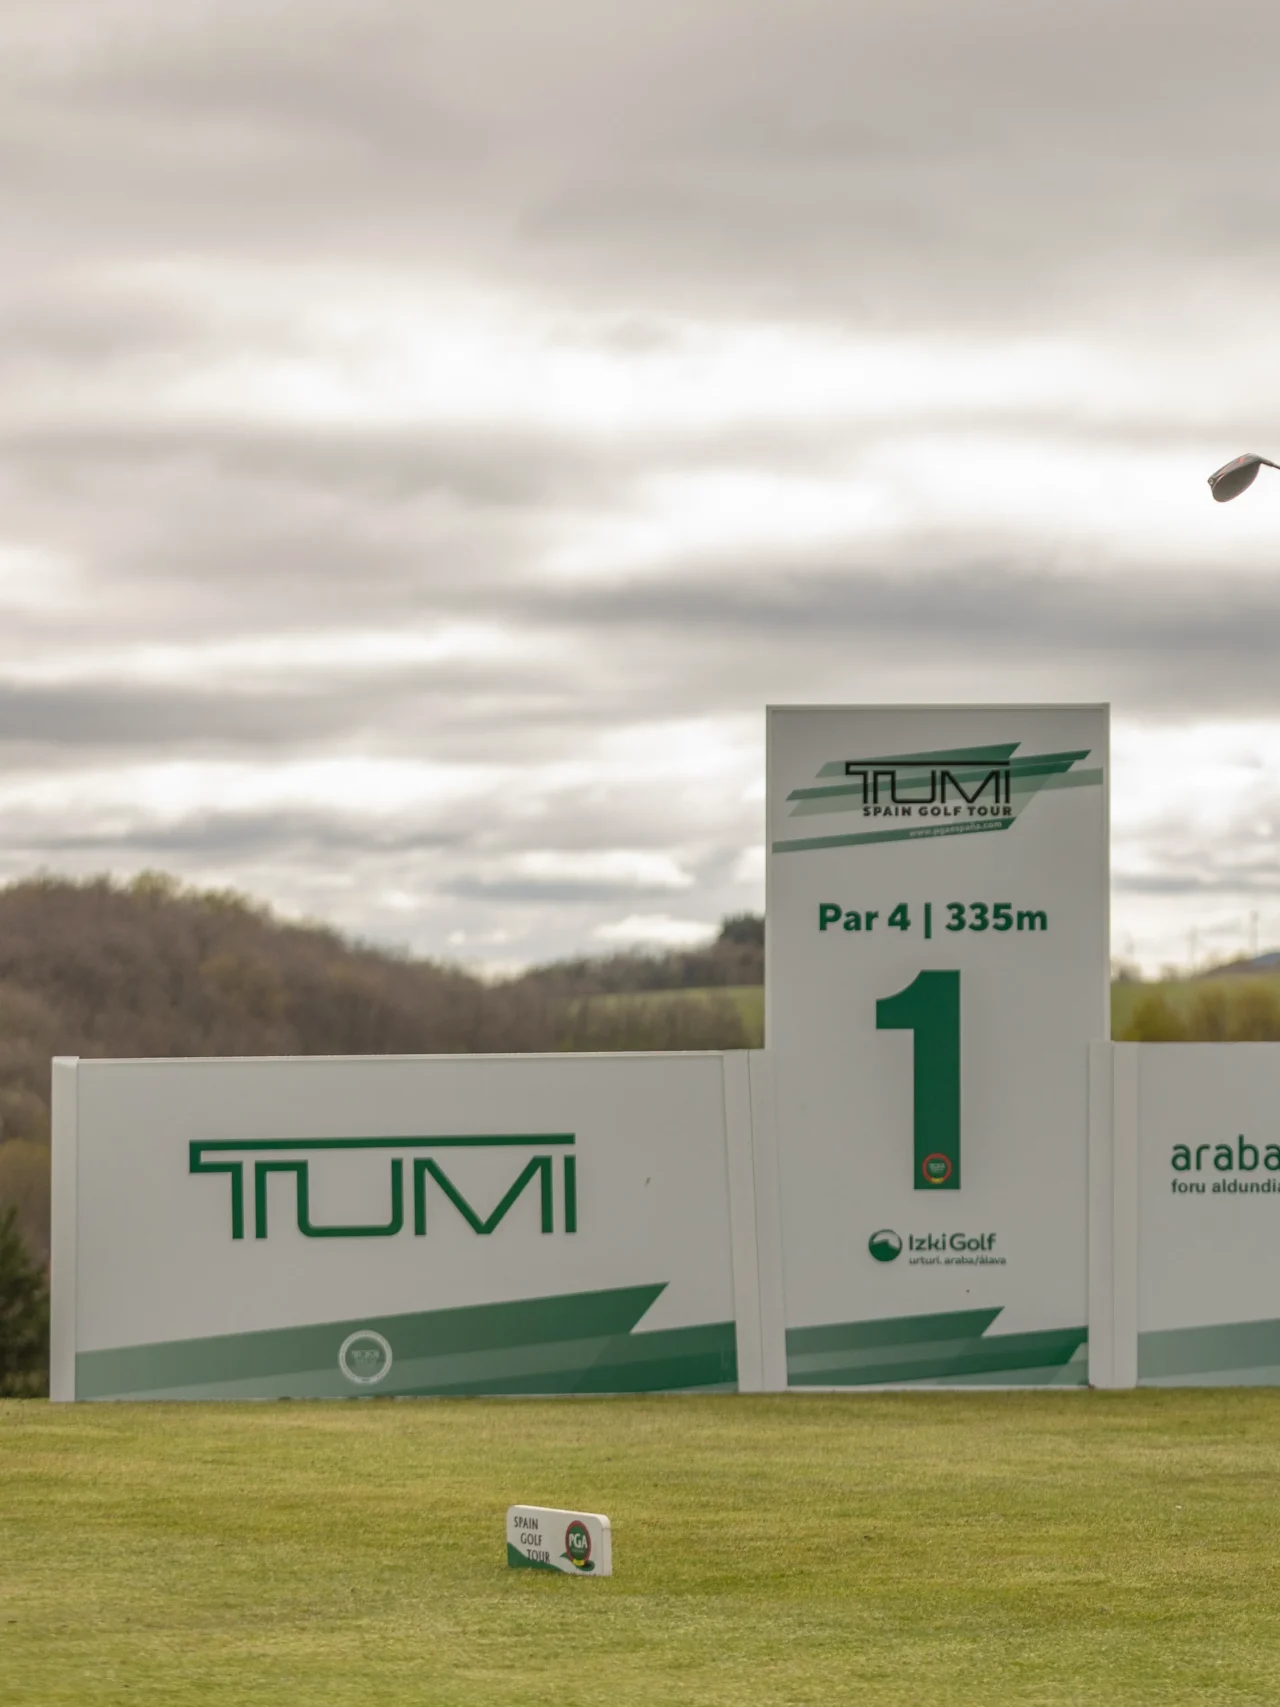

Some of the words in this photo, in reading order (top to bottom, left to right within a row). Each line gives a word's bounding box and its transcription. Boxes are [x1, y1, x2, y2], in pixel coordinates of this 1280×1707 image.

[845, 760, 1010, 804] TUMI
[863, 806, 912, 817] SPAIN
[918, 806, 962, 817] GOLF
[967, 805, 1013, 817] TOUR
[818, 902, 879, 931] Par
[887, 902, 911, 931] 4
[945, 902, 1048, 931] 335m
[876, 969, 961, 1190] 1
[189, 1133, 577, 1239] TUMI
[1171, 1178, 1206, 1193] foru
[908, 1233, 947, 1251] Izki
[949, 1232, 997, 1251] Golf
[514, 1516, 539, 1530] SPAIN
[520, 1532, 542, 1546] GOLF
[569, 1533, 588, 1549] PGA
[527, 1548, 550, 1563] TOUR
